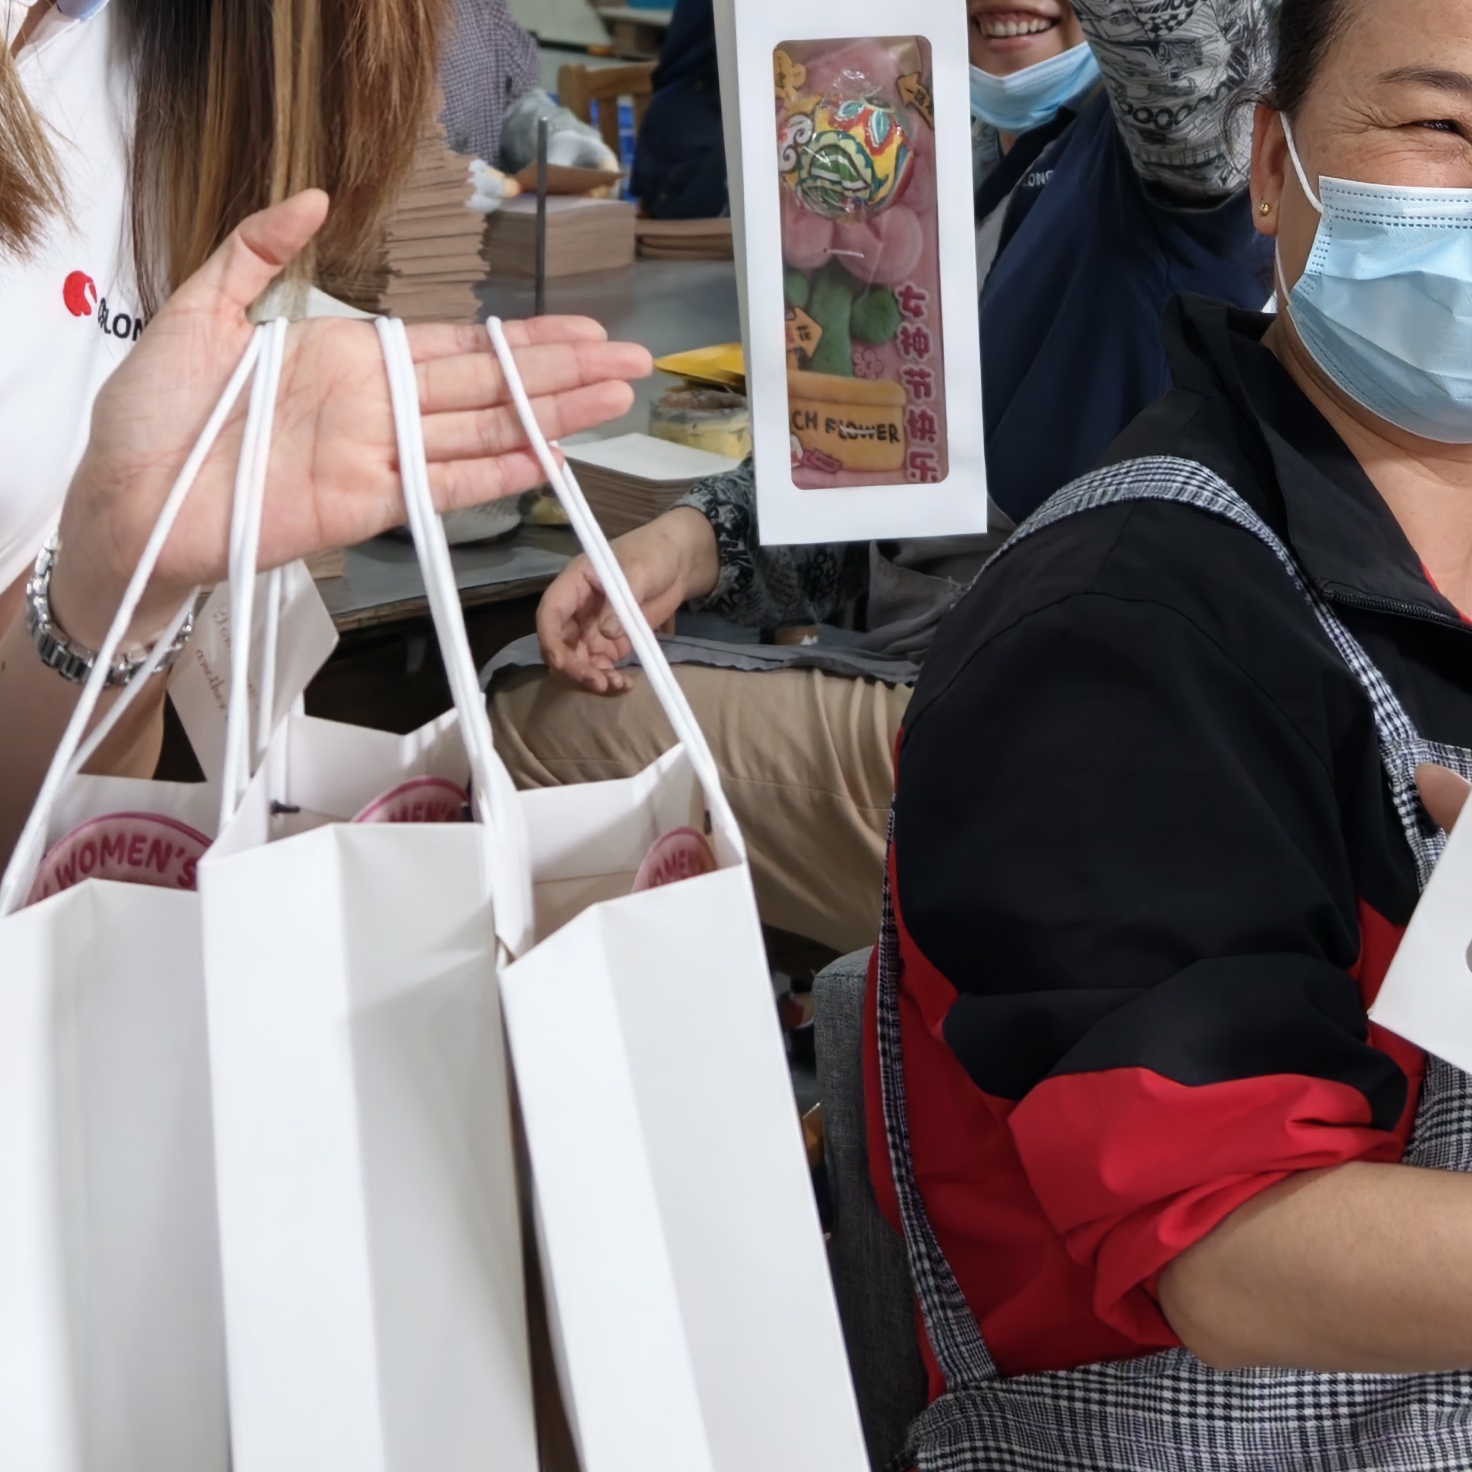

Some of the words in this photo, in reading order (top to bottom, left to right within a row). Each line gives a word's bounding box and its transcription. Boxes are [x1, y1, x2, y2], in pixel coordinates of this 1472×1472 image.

[898, 284, 940, 482] 女神节快乐
[825, 417, 900, 444] FLOWER
[54, 832, 198, 891] WOMEN'S
